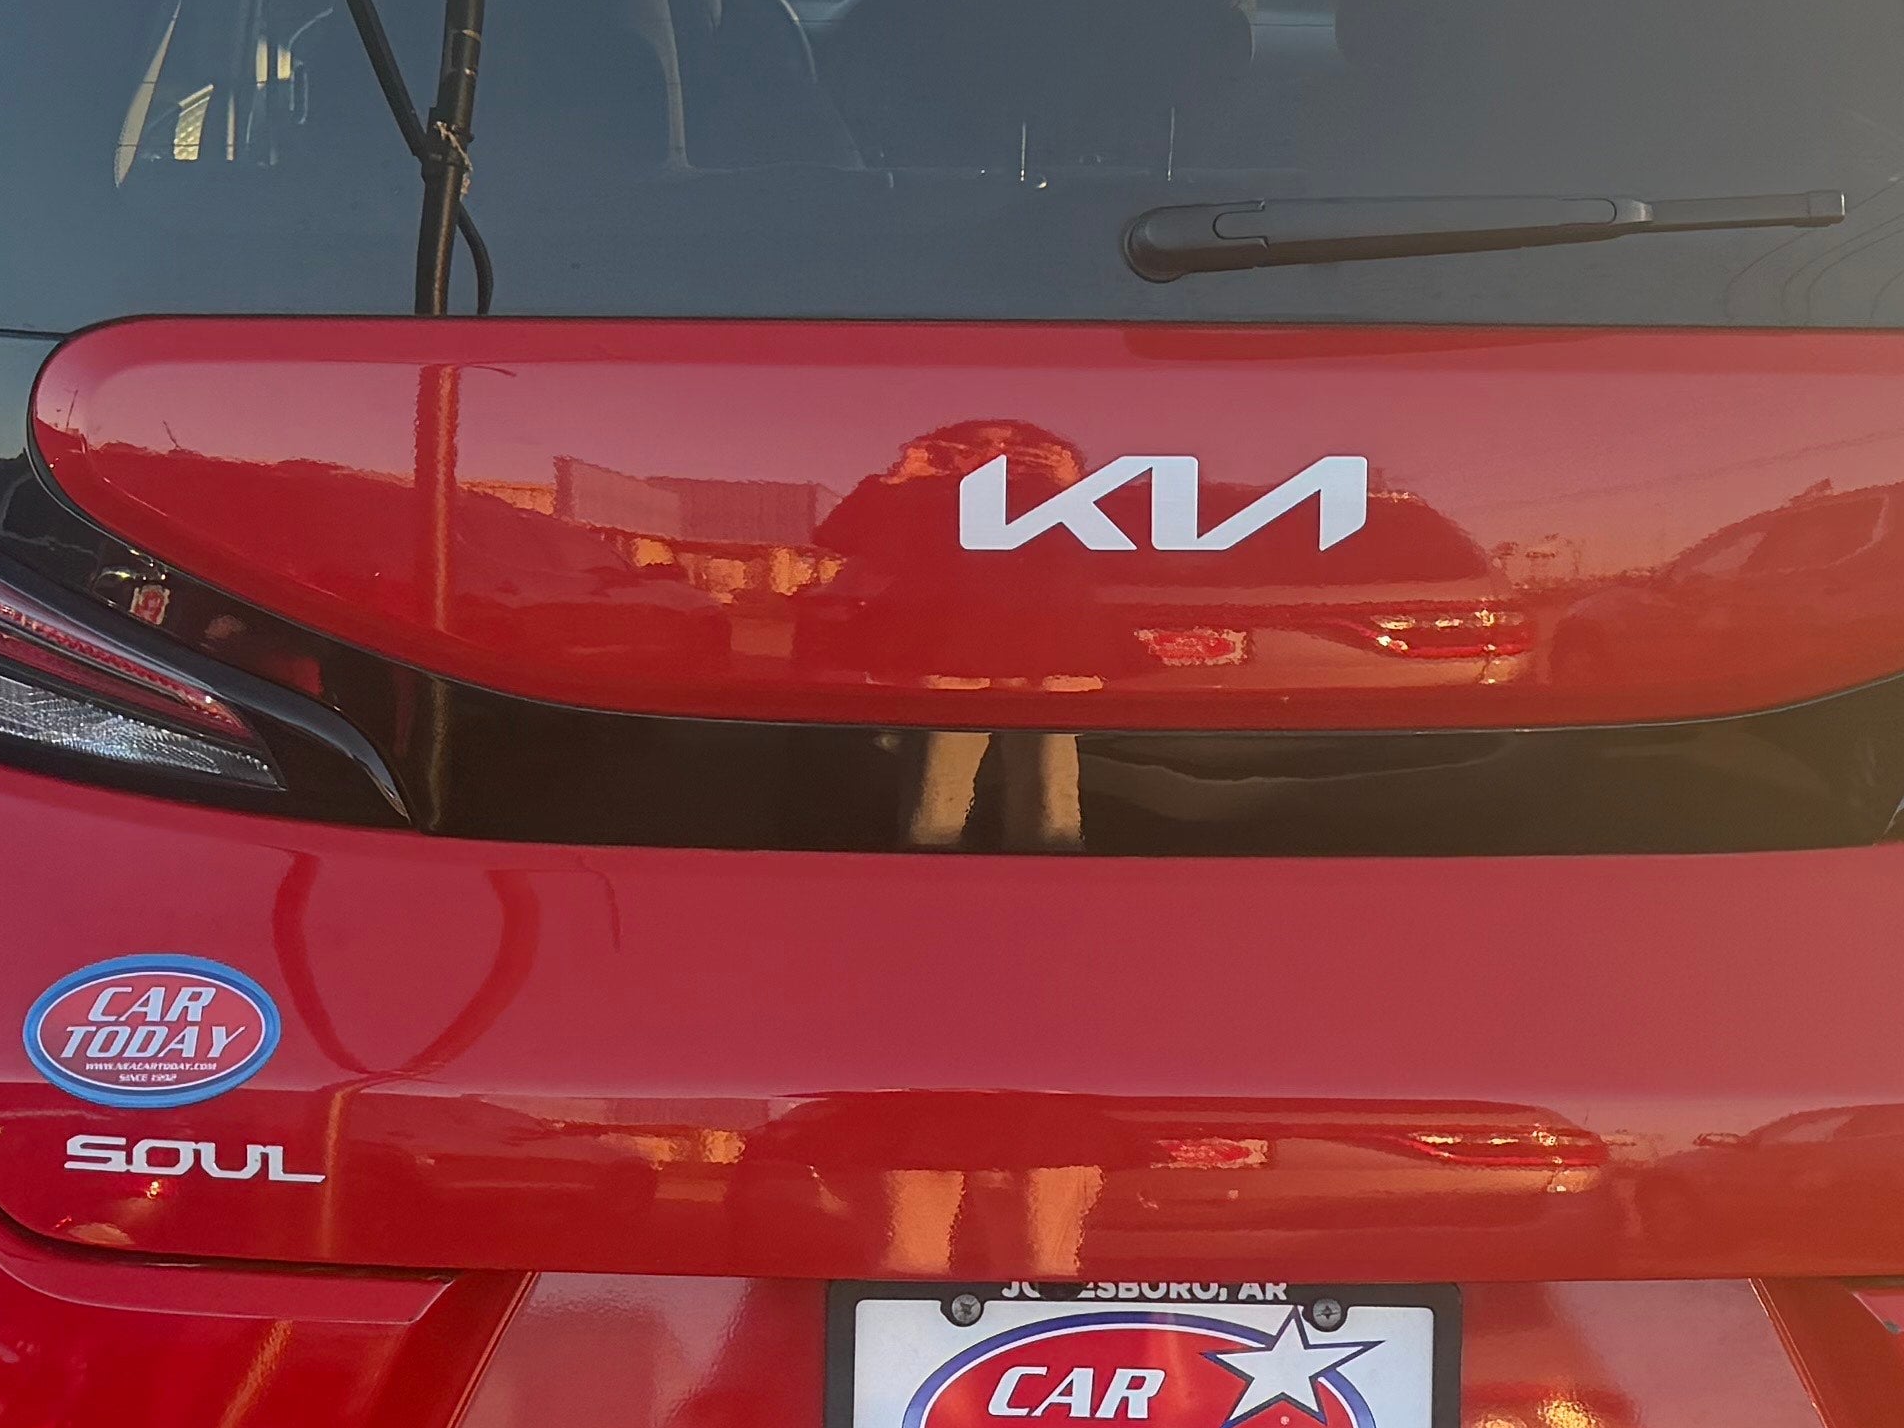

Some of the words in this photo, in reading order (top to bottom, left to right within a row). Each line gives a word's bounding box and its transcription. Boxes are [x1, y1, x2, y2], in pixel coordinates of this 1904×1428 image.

[88, 986, 216, 1022] CAR
[60, 1025, 246, 1058] TODAY
[64, 1134, 326, 1183] SOUL
[987, 1366, 1165, 1420] CAR
